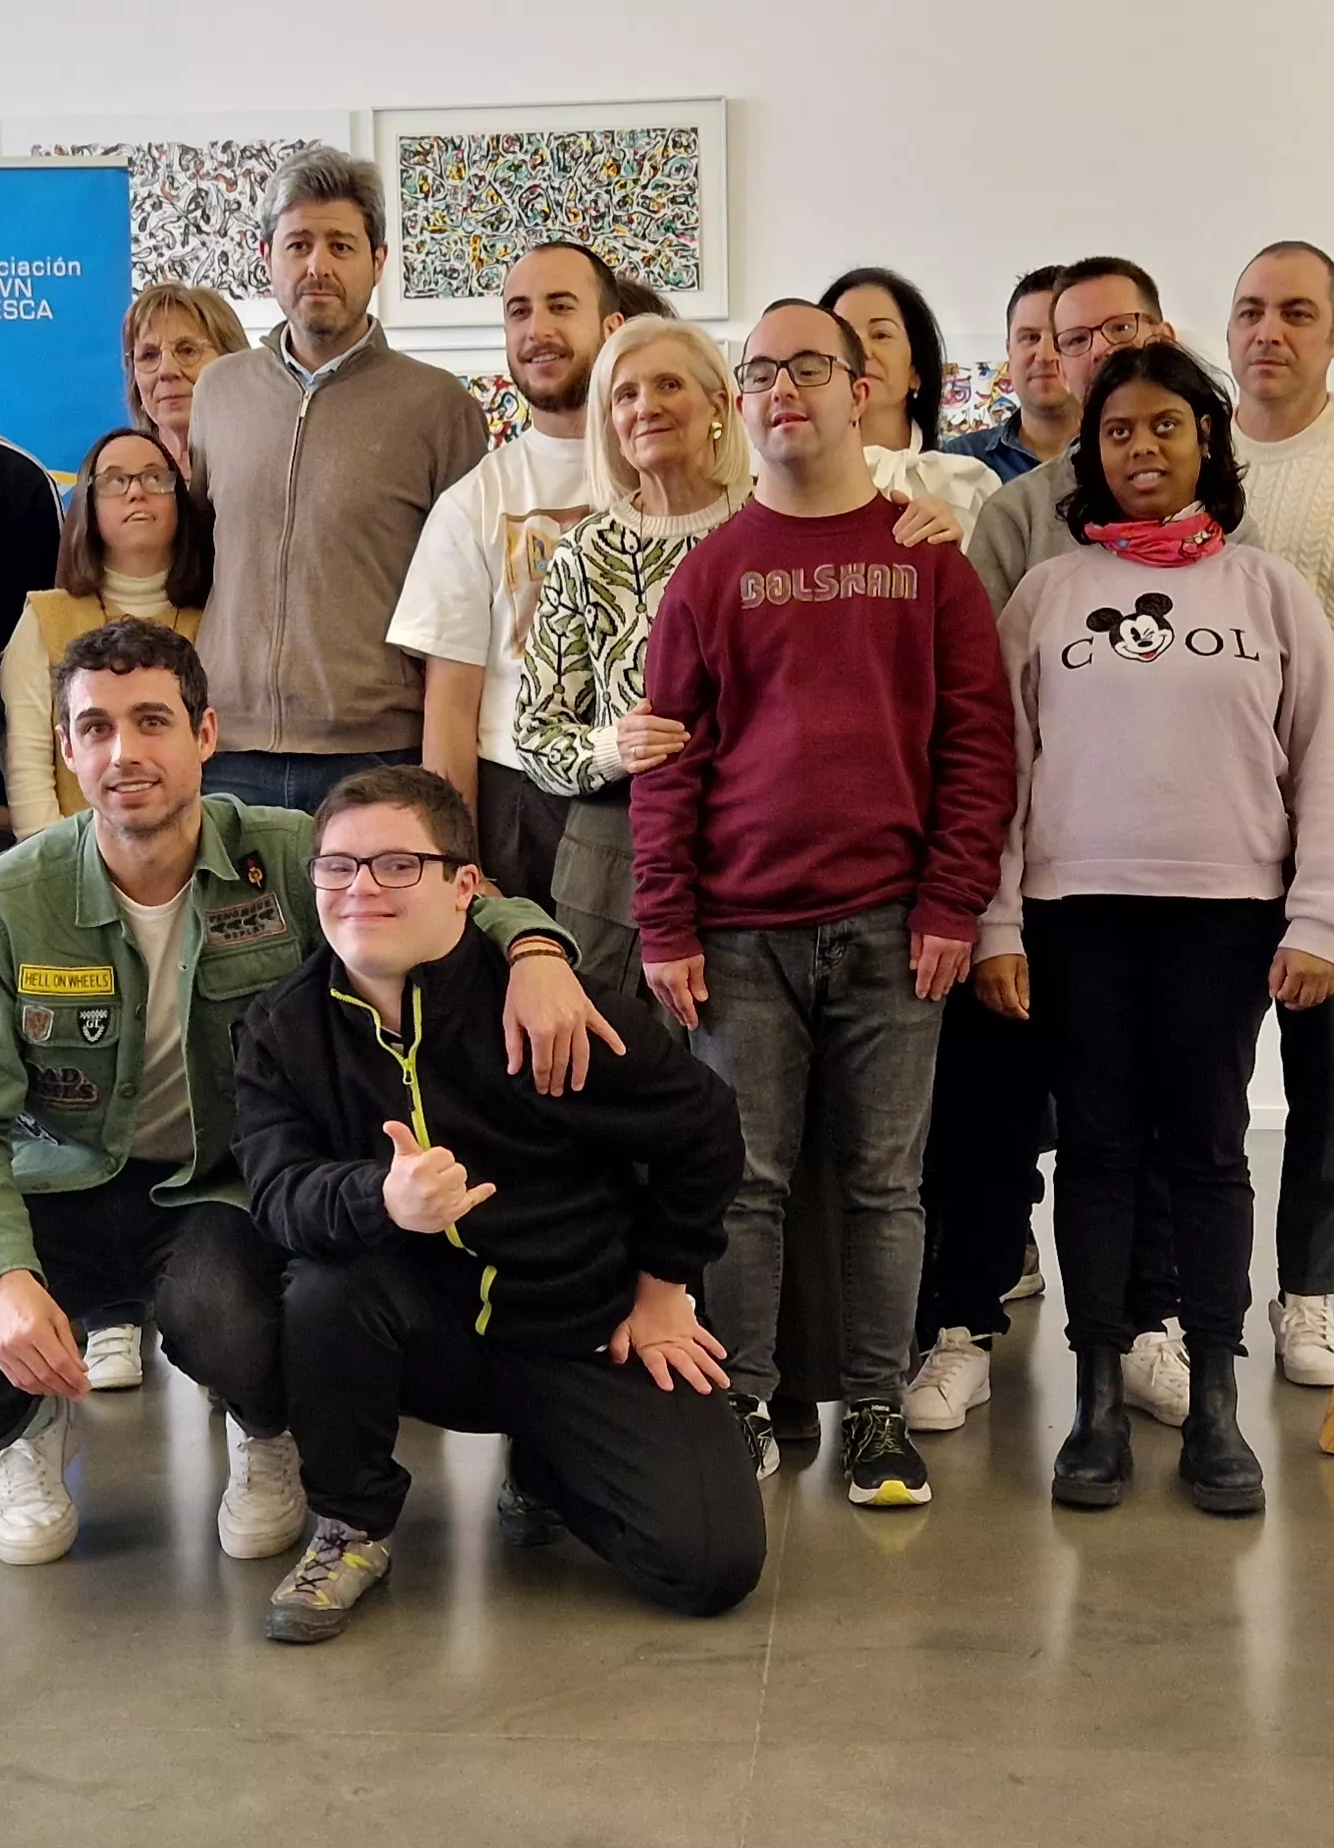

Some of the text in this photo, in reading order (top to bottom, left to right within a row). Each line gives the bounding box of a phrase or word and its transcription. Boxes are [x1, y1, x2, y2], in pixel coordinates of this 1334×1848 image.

[740, 563, 917, 610] BOLSKAN
[25, 972, 109, 988] HELL ON WHEELS
